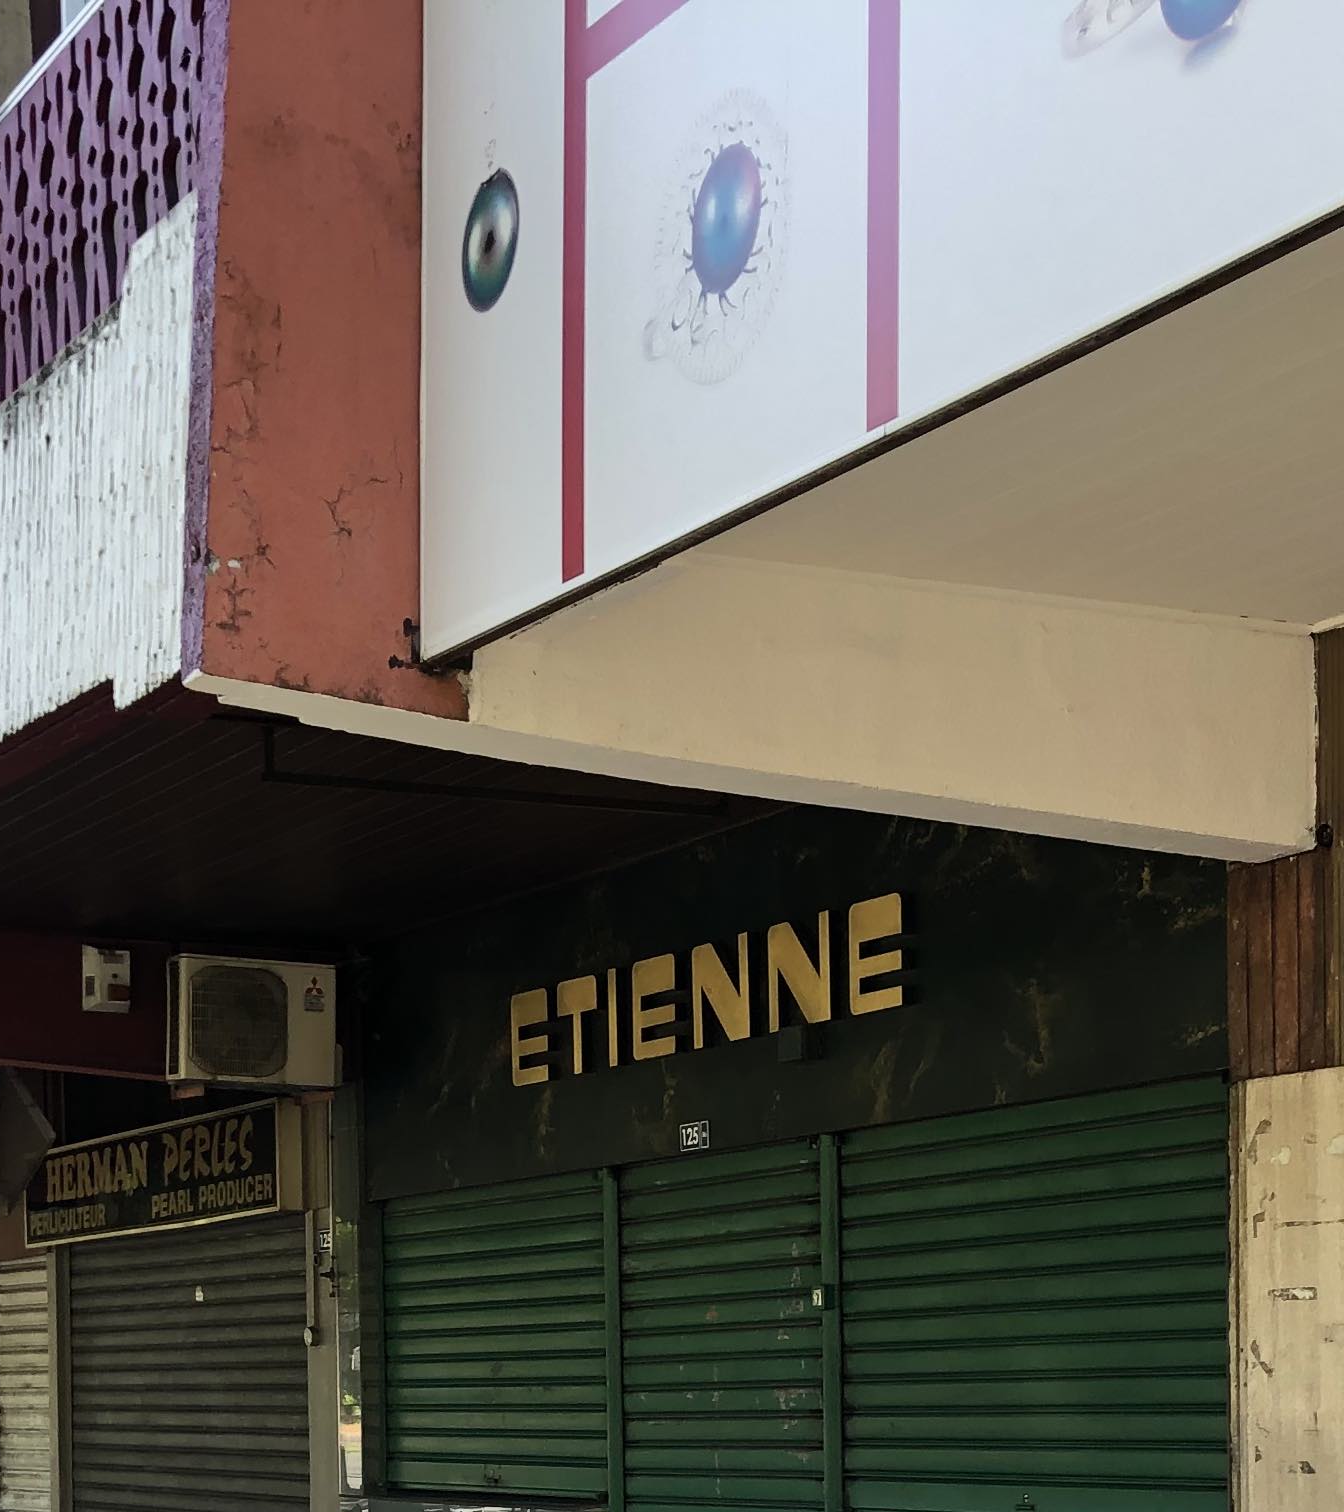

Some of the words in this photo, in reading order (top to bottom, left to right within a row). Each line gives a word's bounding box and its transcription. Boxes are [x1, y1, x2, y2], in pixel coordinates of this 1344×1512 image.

[510, 892, 903, 1087] ETIENNE
[45, 1140, 149, 1204] HERMAN
[161, 1113, 254, 1187] PERLES
[681, 1126, 699, 1147] 125
[29, 1203, 106, 1237] PERLICULTEUR
[151, 1187, 194, 1220] PEARL
[198, 1172, 274, 1211] PRODUCER
